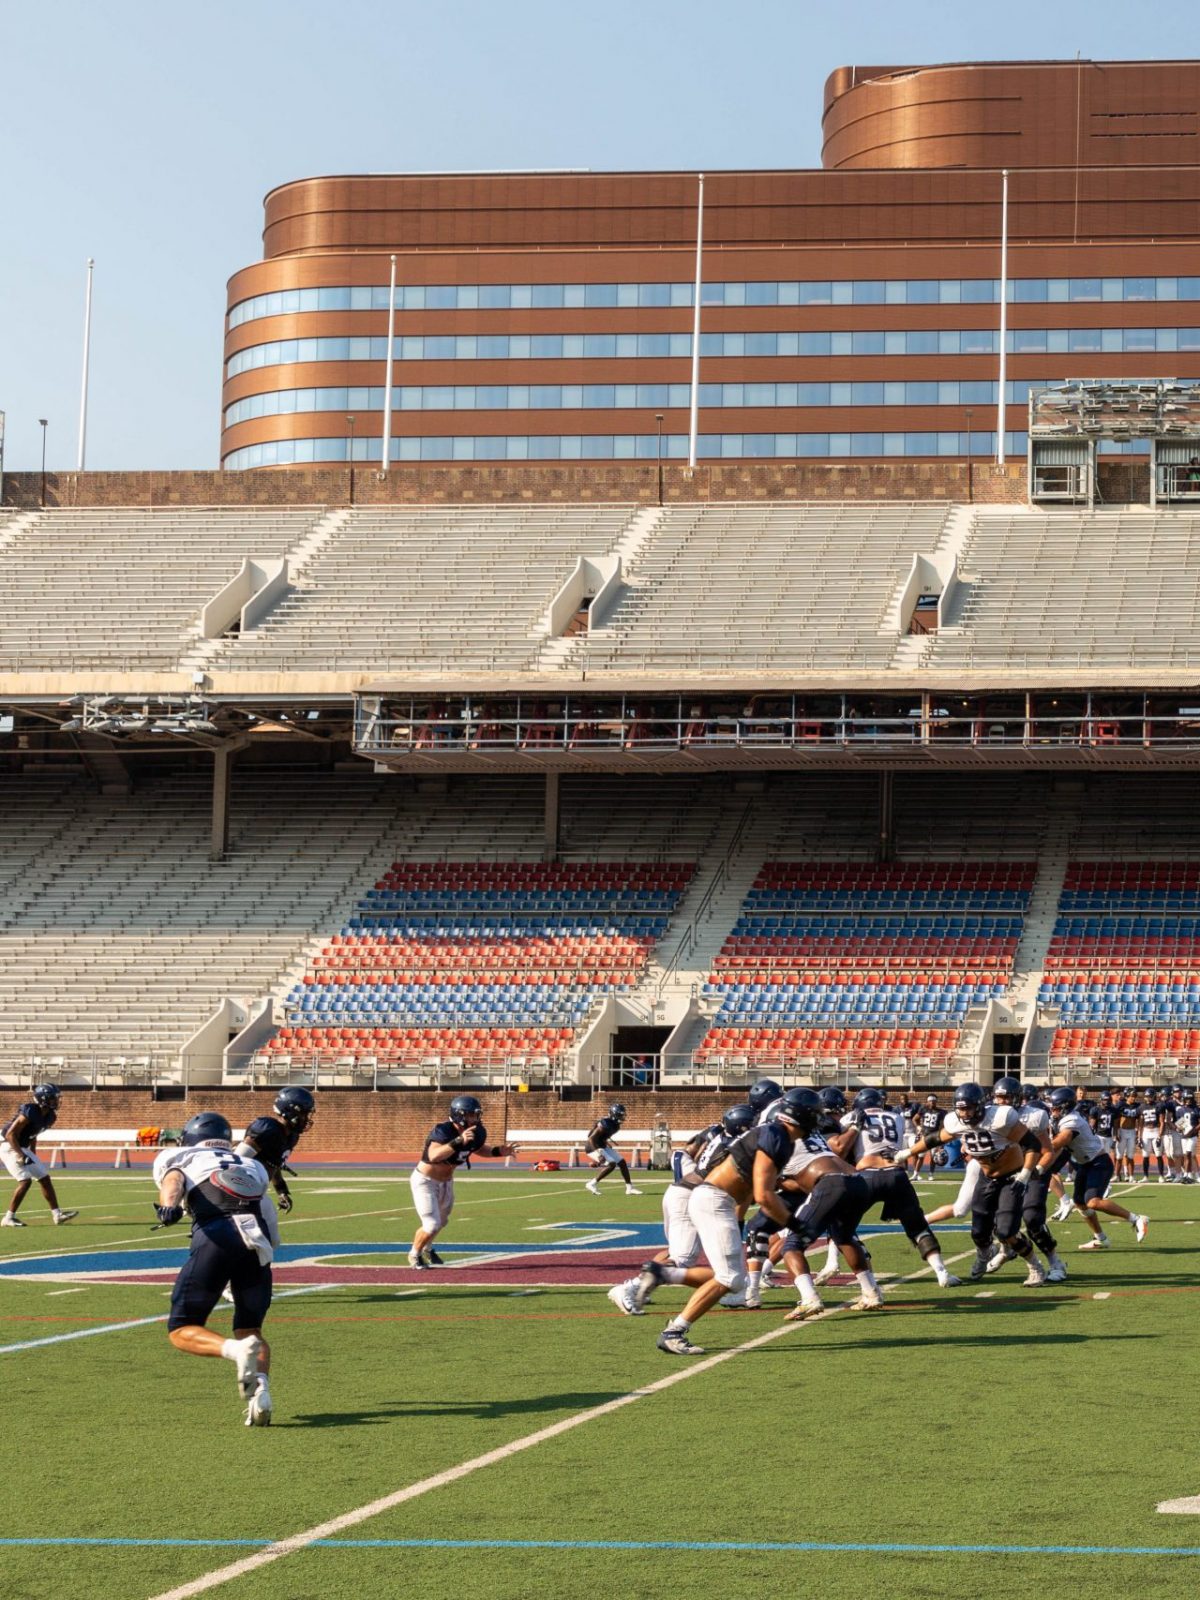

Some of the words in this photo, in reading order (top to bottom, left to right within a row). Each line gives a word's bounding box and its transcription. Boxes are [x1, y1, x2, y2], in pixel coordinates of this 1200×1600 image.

[923, 1112, 938, 1128] 28
[1100, 1114, 1111, 1129] 31
[864, 1114, 898, 1144] 58
